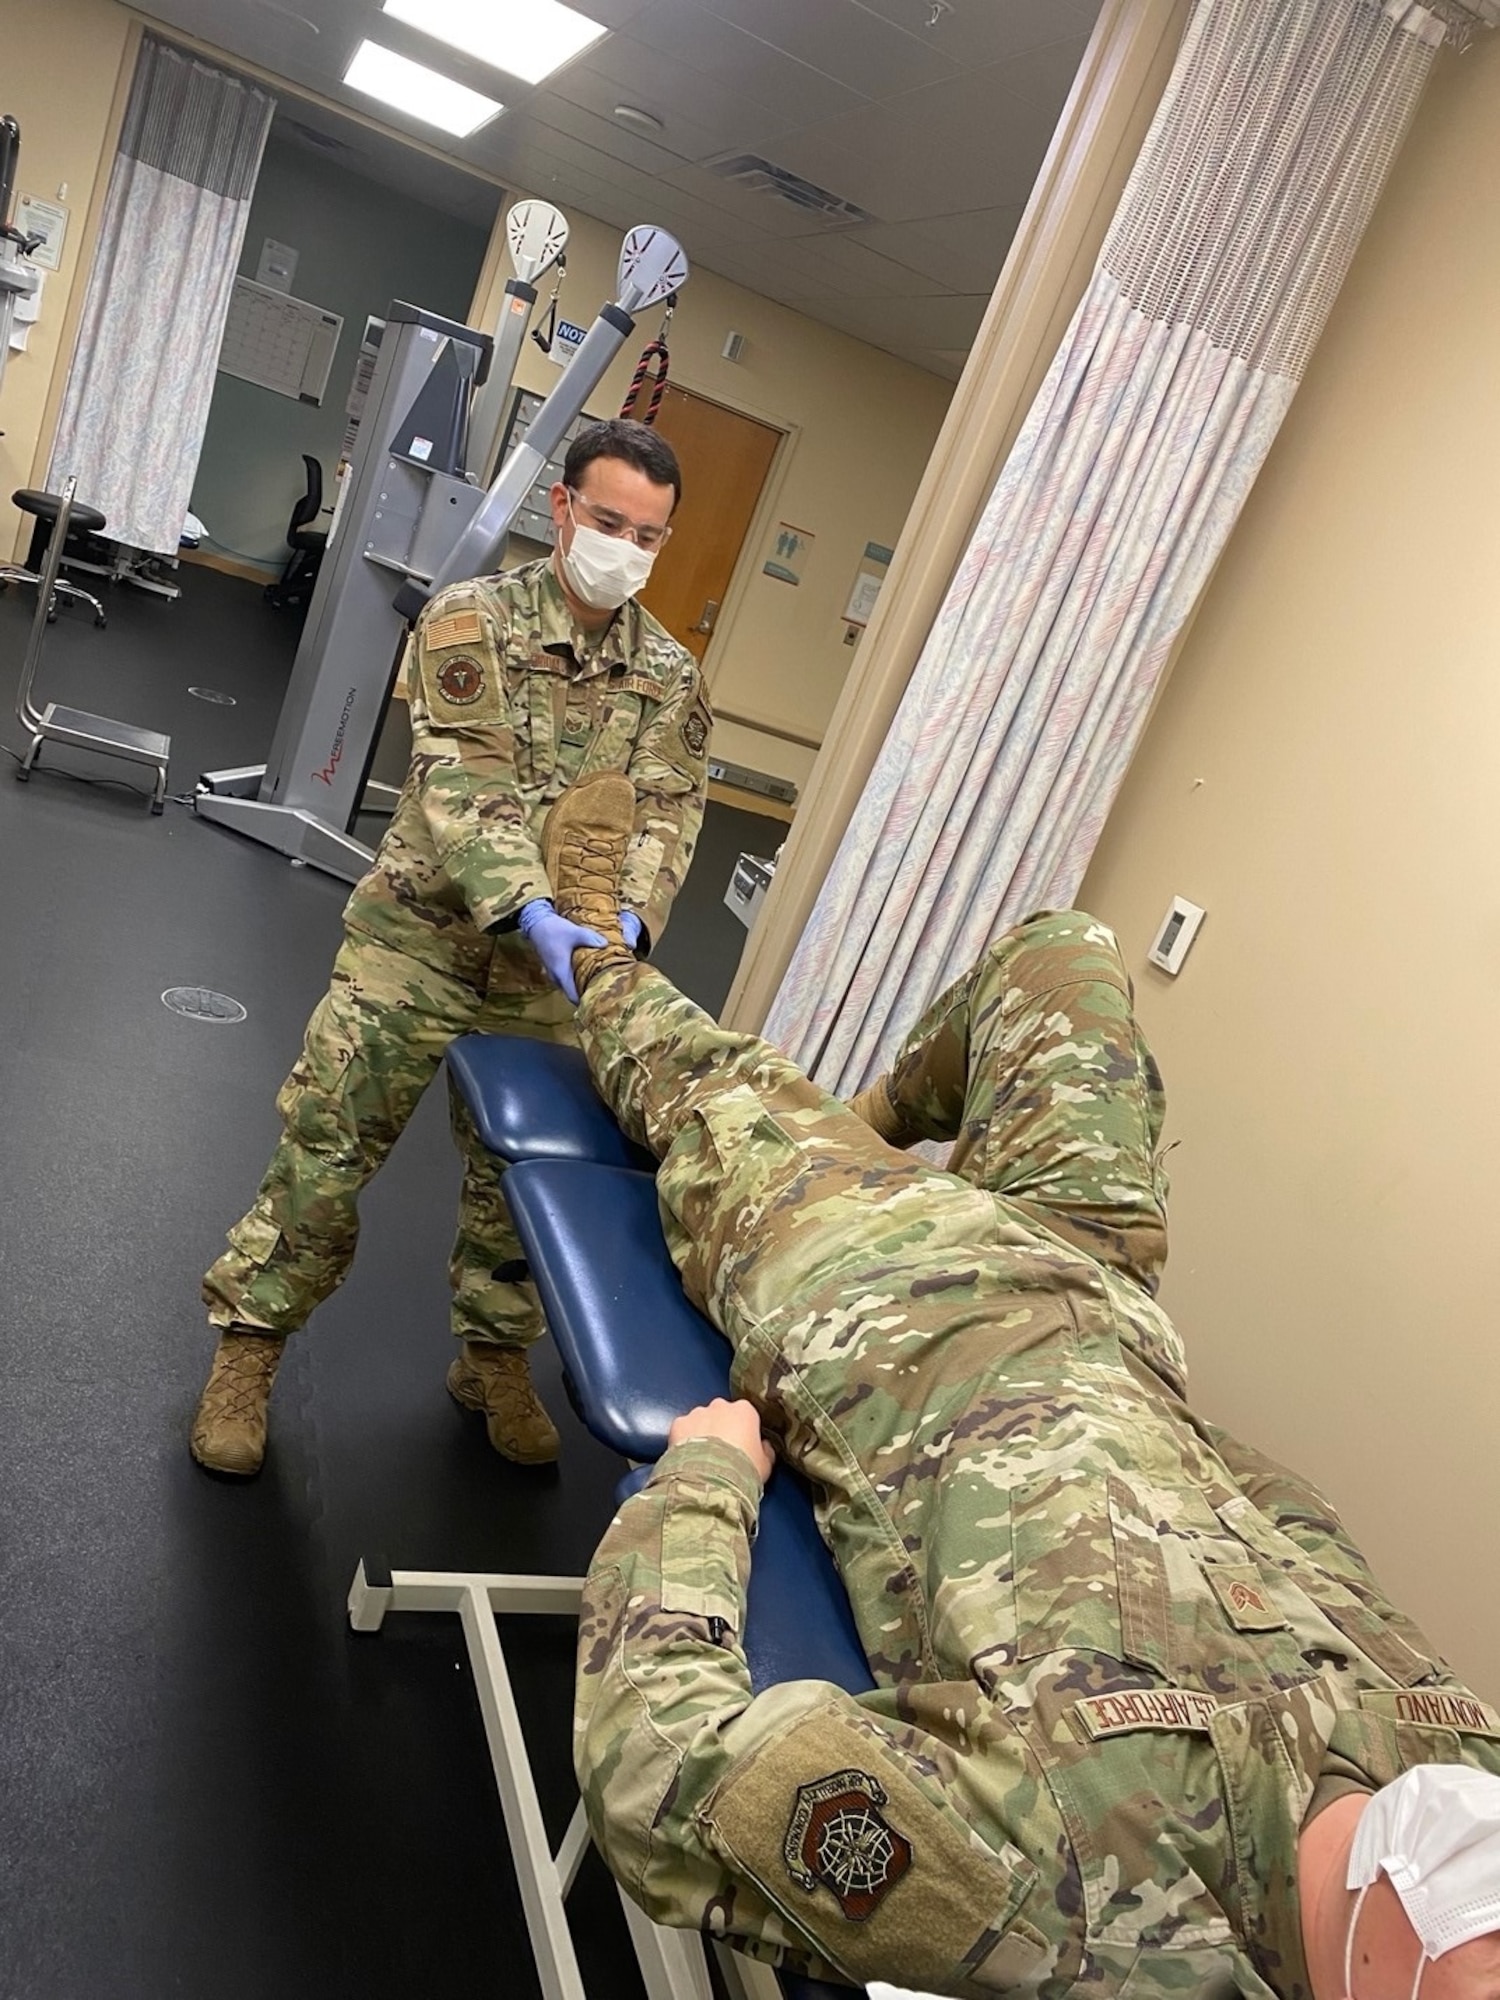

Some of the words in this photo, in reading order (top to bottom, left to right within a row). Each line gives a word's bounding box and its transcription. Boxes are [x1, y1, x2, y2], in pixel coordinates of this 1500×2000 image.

[558, 324, 587, 342] NOT
[1086, 1693, 1163, 1729] FORCE
[1154, 1694, 1191, 1726] AIR
[786, 1808, 809, 1861] COMMAND
